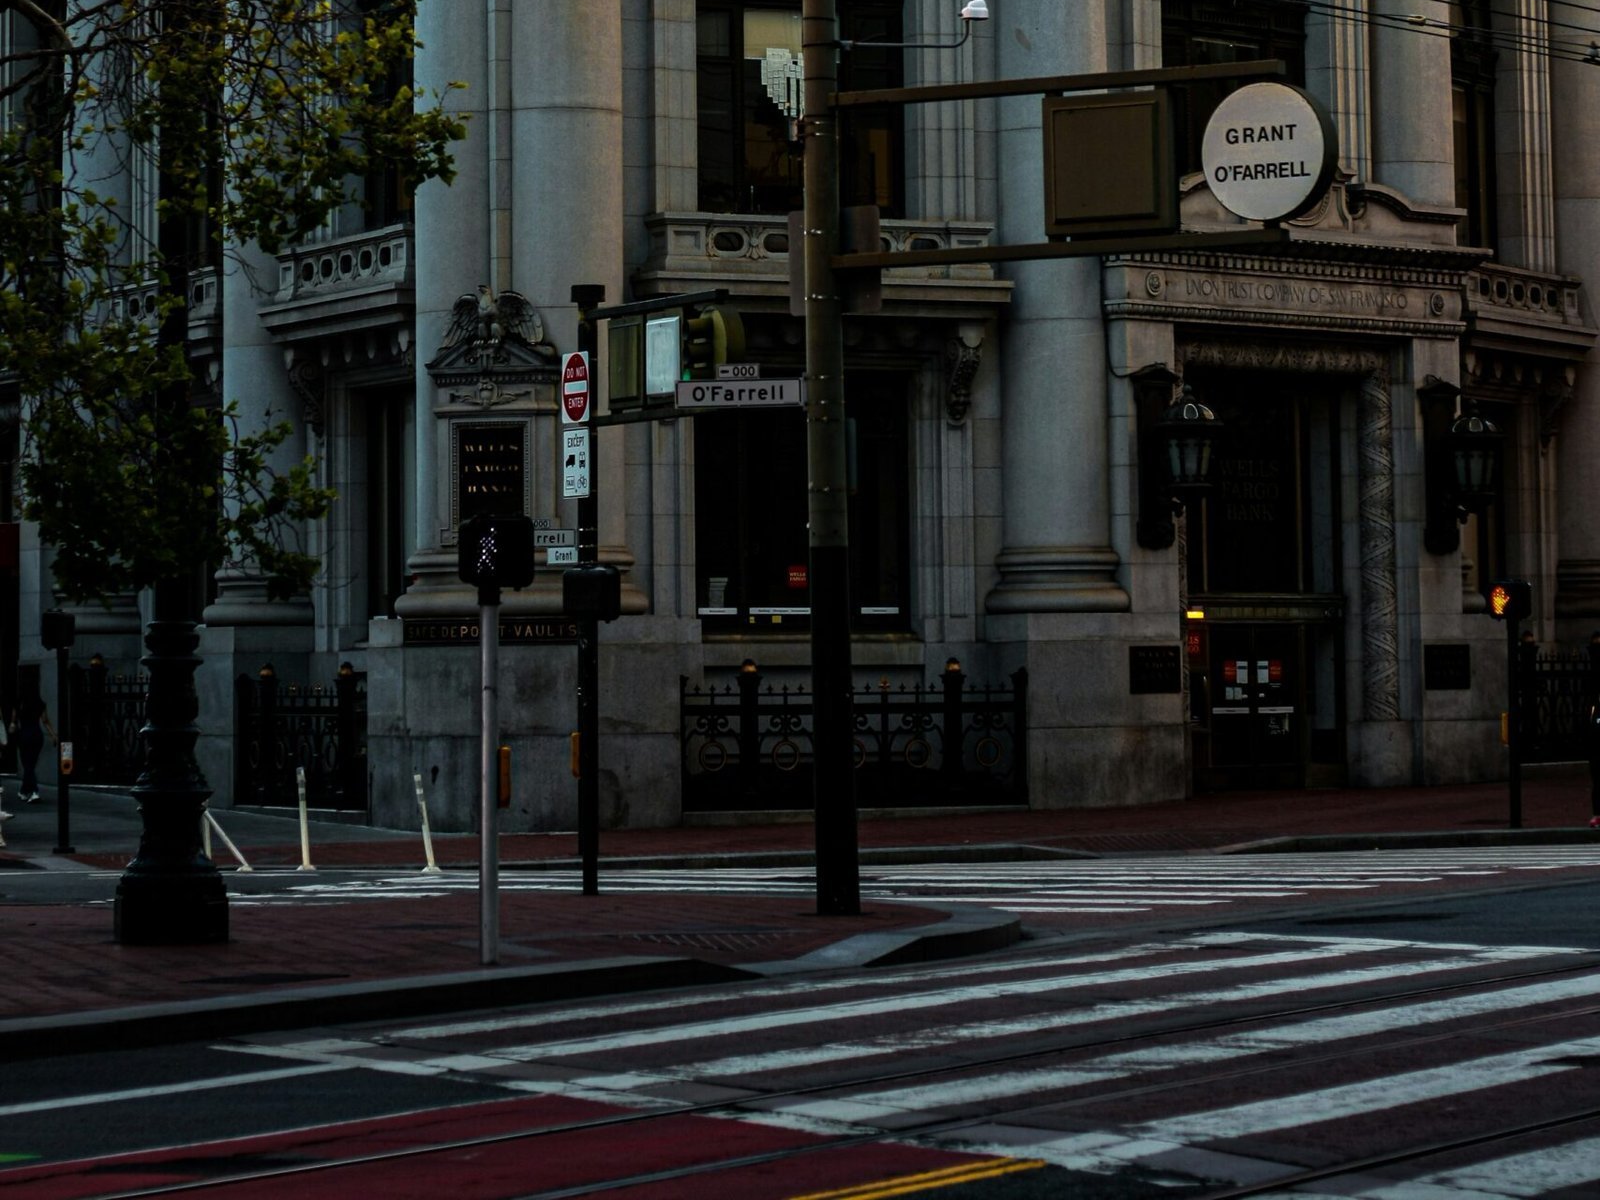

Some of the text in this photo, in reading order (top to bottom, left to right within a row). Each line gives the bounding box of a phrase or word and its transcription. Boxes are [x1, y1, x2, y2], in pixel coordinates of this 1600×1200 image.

[1225, 124, 1297, 145] GRANT
[1214, 161, 1311, 183] O'FARRELL
[1222, 280, 1253, 299] TRUST
[1257, 283, 1306, 302] COMPANY
[1309, 287, 1326, 303] OF
[566, 366, 586, 379] DO NOT
[732, 366, 756, 377] 000
[692, 385, 784, 402] O'Farrell
[568, 397, 584, 409] ENTER
[567, 435, 585, 449] EXCEPT
[441, 624, 506, 639] DEPOT
